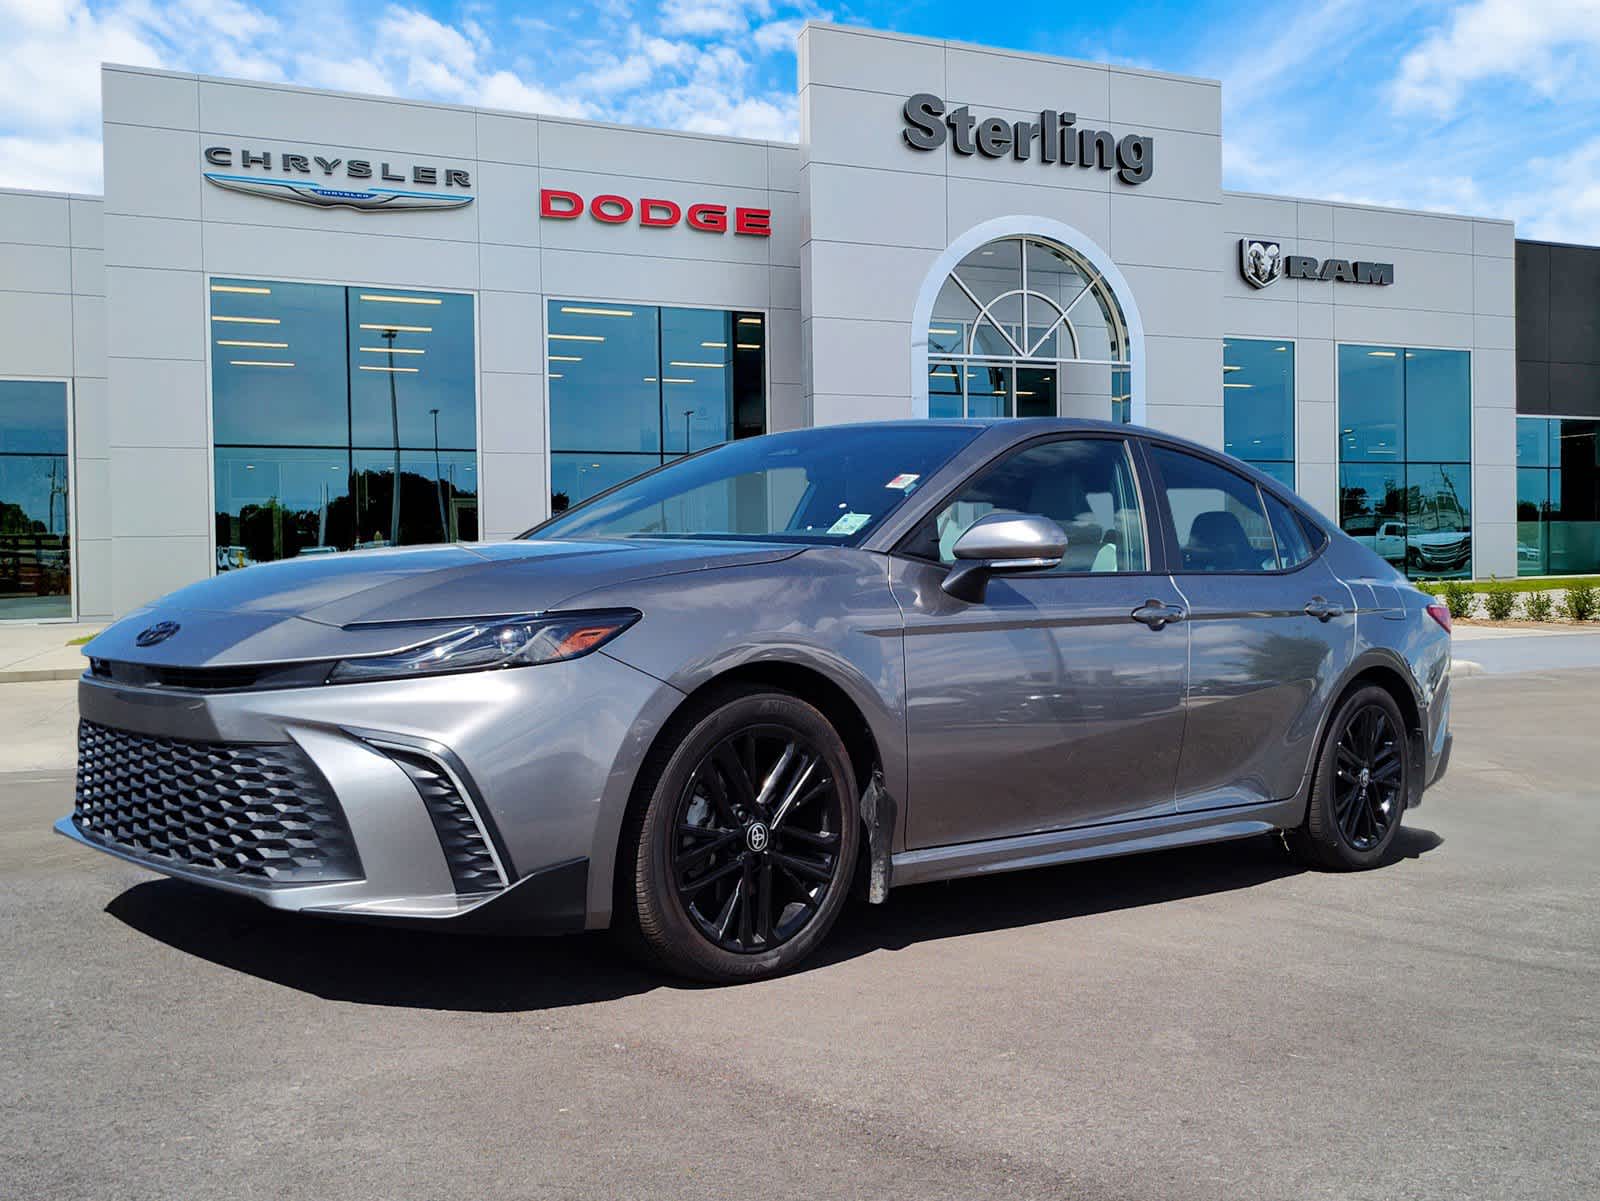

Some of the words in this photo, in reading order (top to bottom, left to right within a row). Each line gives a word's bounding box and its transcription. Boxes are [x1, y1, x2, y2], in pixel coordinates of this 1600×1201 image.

[903, 93, 1154, 185] Sterling
[204, 146, 472, 188] CHRYSLER
[539, 188, 771, 236] DODGE
[1284, 255, 1395, 286] RAM
